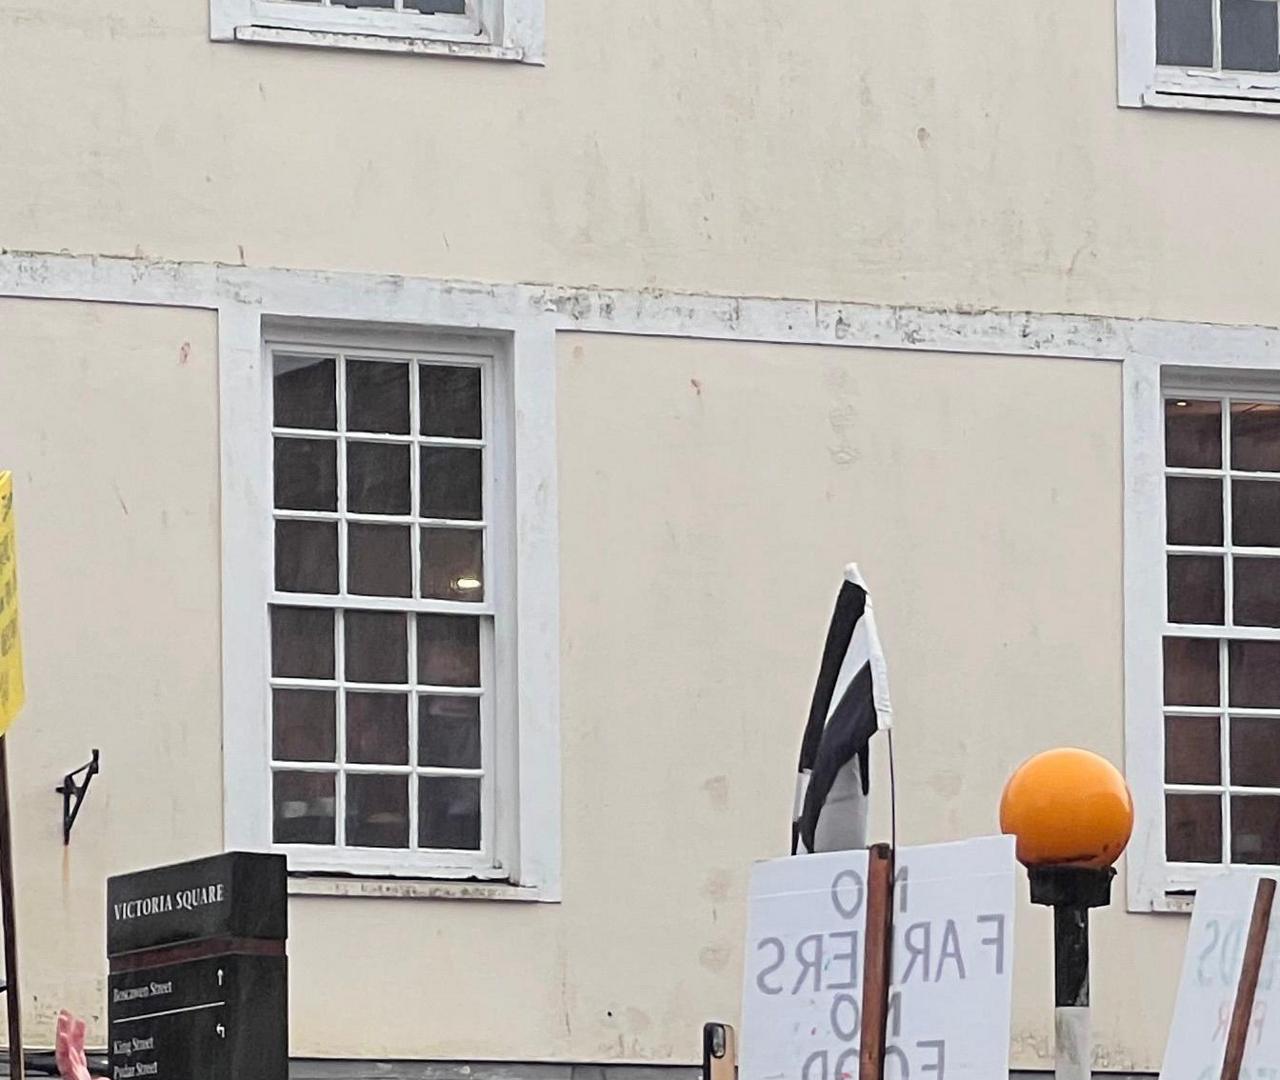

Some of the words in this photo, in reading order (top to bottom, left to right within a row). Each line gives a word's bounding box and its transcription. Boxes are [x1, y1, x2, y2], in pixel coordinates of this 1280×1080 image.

[114, 894, 172, 920] VICTORIA
[176, 884, 224, 910] SQUARE
[150, 981, 172, 995] Street
[132, 1037, 154, 1051] Street
[136, 1061, 158, 1076] Street
